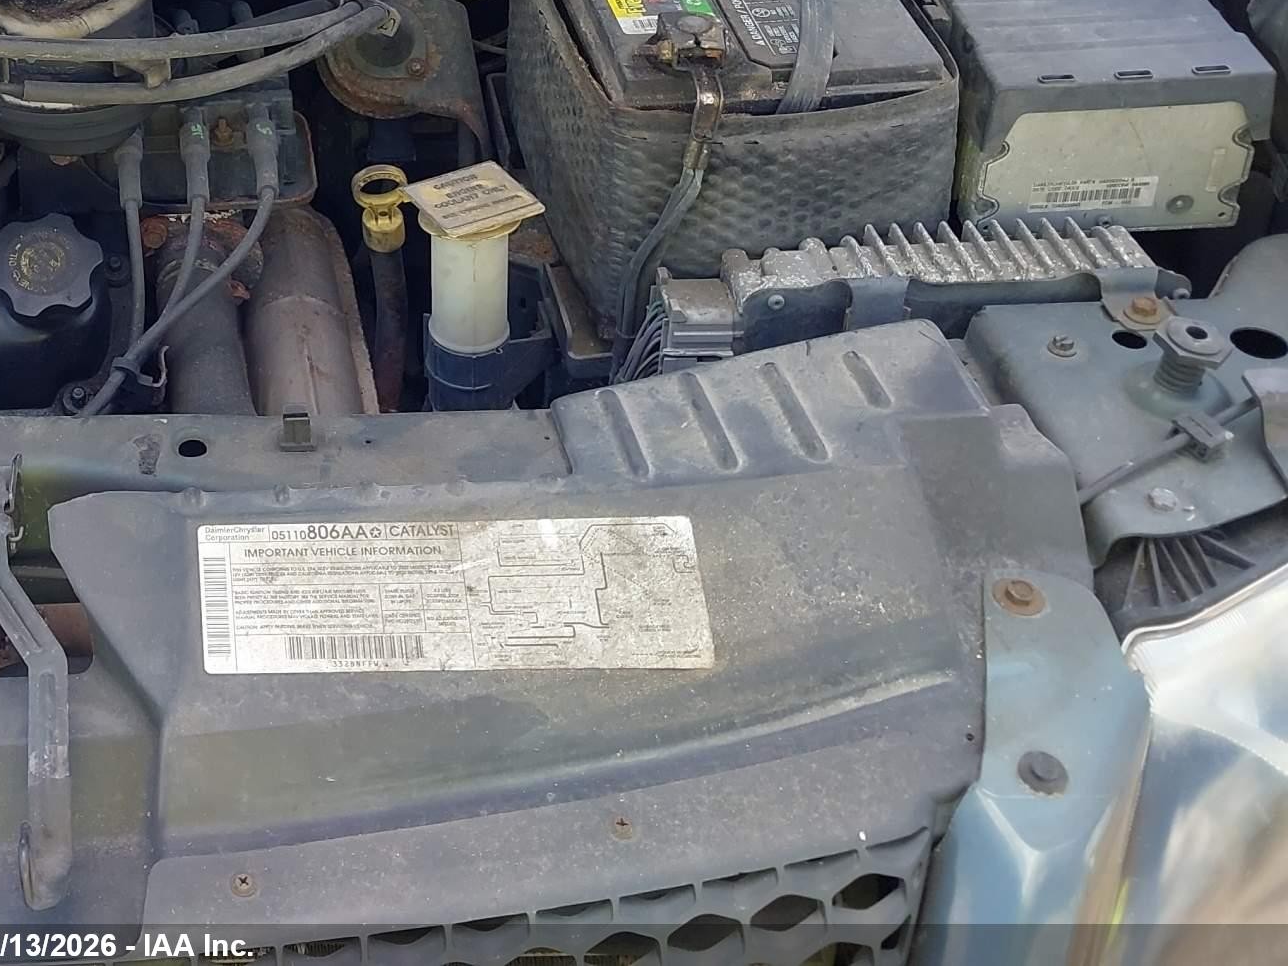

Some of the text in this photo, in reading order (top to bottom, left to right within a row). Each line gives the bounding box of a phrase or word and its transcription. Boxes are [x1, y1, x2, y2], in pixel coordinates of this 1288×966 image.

[738, 11, 758, 40] DANGER
[204, 525, 265, 535] DaimlerChrysler
[272, 524, 454, 541] 05110806AA CATALYST
[205, 534, 249, 542] Corporation
[244, 545, 441, 558] IMPORTANT VEHICLE INFORMATION
